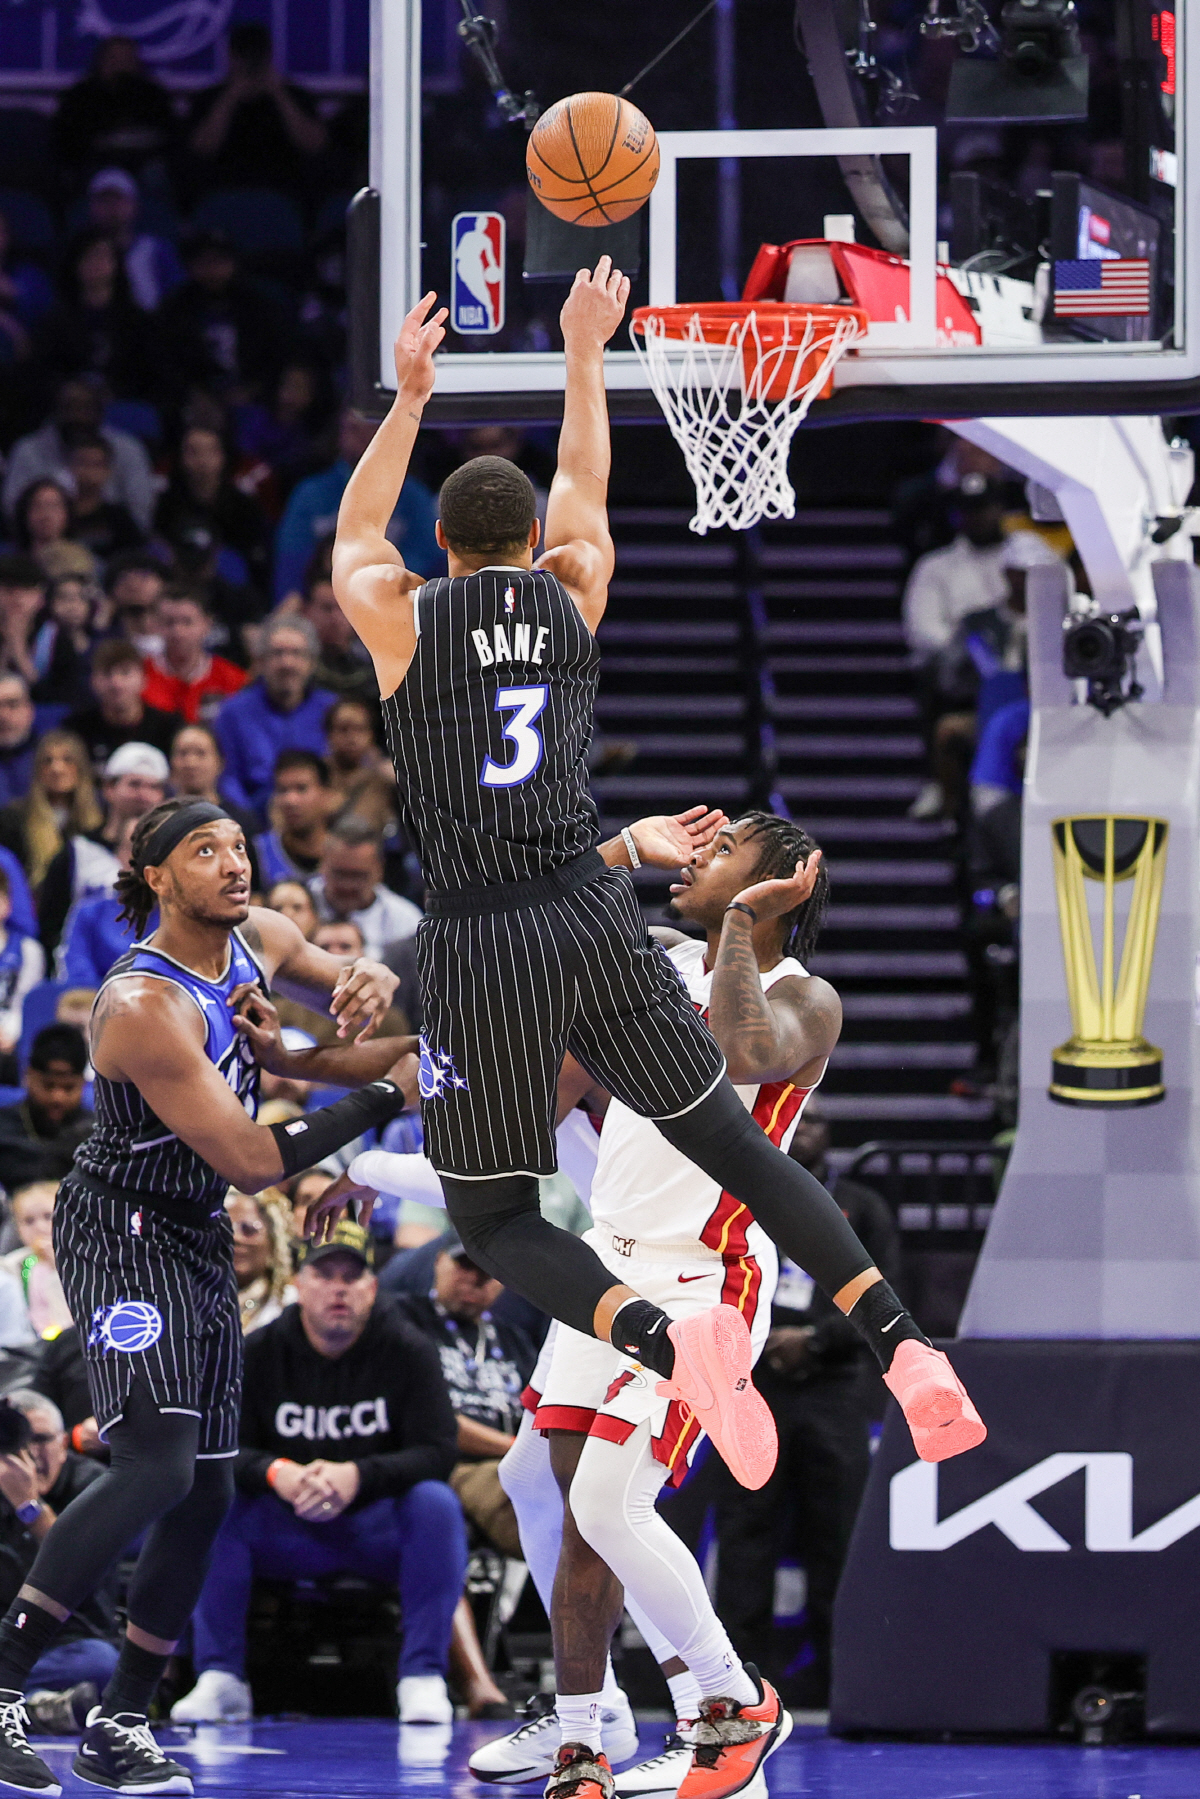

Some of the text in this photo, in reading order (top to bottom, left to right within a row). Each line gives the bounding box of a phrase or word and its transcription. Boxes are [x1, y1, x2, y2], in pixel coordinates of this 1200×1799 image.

[459, 305, 485, 326] NBA
[471, 623, 550, 667] BANE
[479, 684, 550, 788] 3
[275, 1397, 389, 1440] GUCCI
